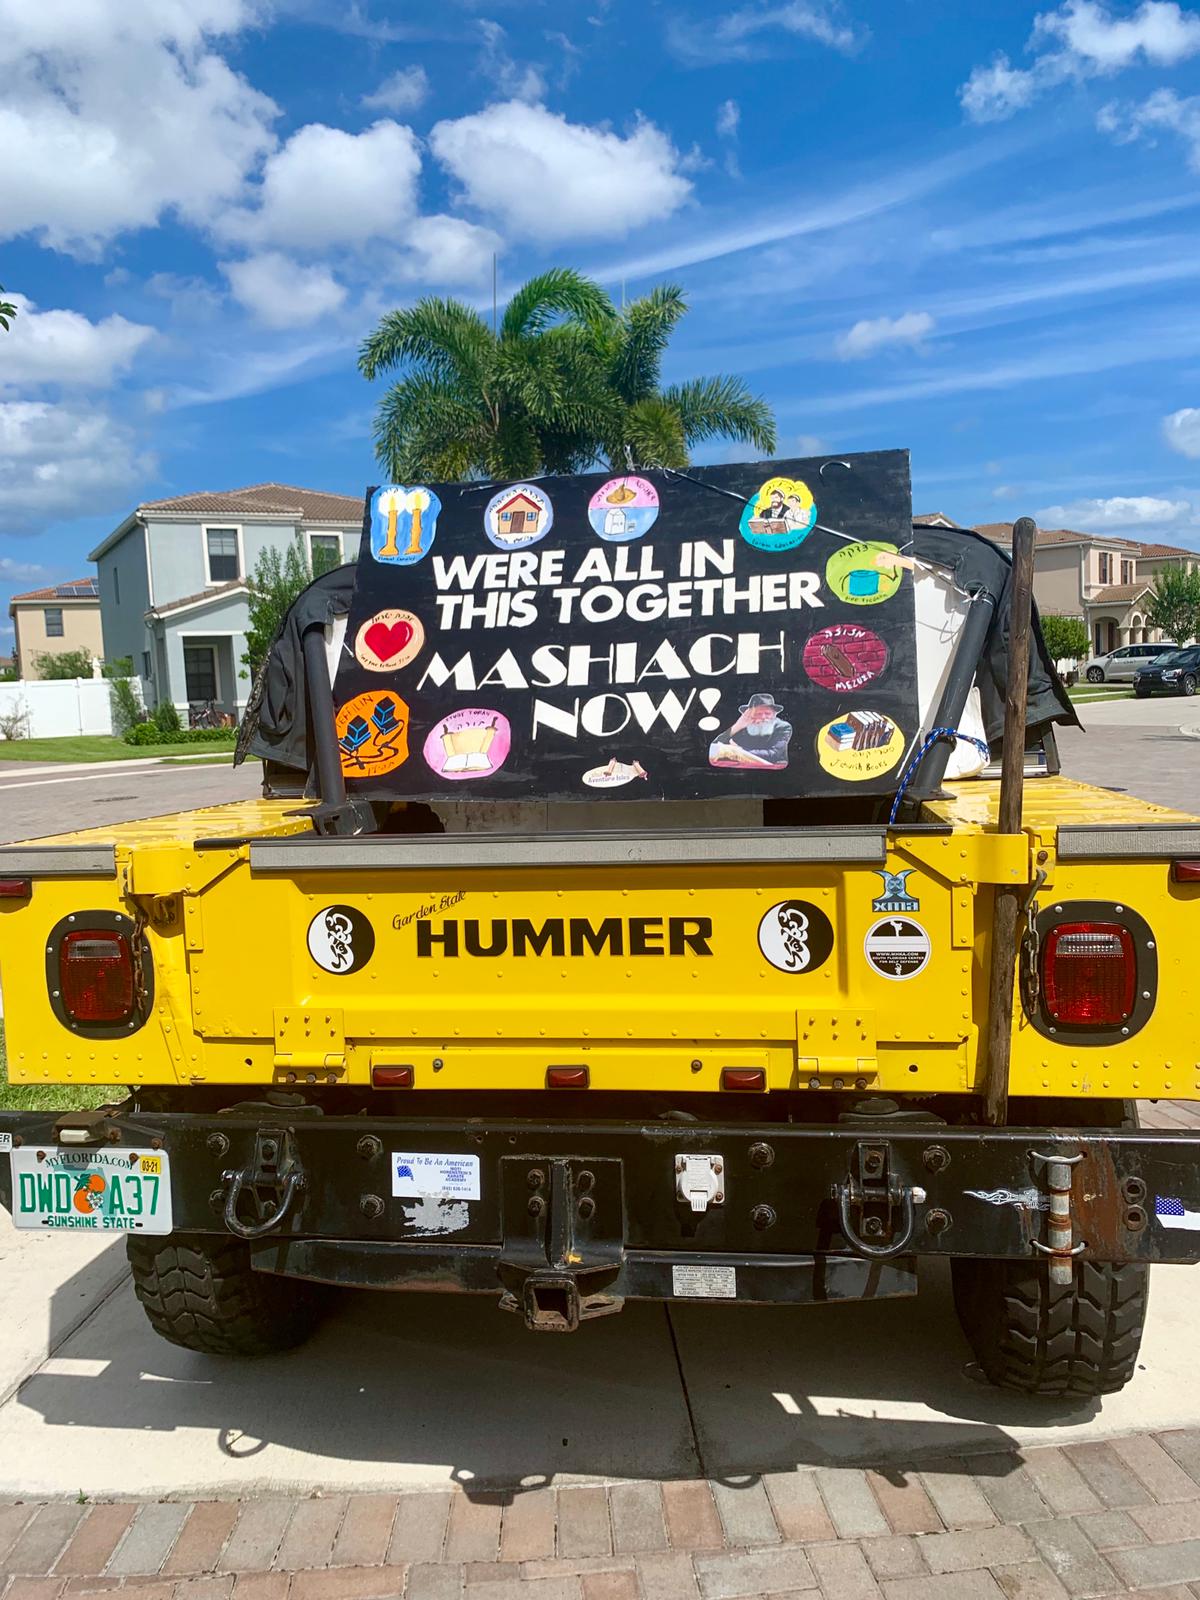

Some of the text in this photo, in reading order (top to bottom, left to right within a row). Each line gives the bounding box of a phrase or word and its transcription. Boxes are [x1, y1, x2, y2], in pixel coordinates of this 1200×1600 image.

[432, 539, 734, 590] WERE ALL IN
[436, 571, 825, 630] THIS TOGETHER
[416, 631, 785, 690] MASHIACH
[532, 687, 722, 741] NOW!
[392, 904, 437, 930] Garden
[416, 917, 714, 957] HUMMER
[45, 1152, 133, 1170] MYFLORIDA.COM
[141, 1160, 158, 1173] 03-21
[397, 1156, 414, 1164] Proud
[416, 1157, 423, 1165] To
[434, 1158, 443, 1166] An
[444, 1159, 474, 1167] American
[19, 1173, 160, 1215] DWD A37
[47, 1215, 135, 1229] SUNSHINE STATE
